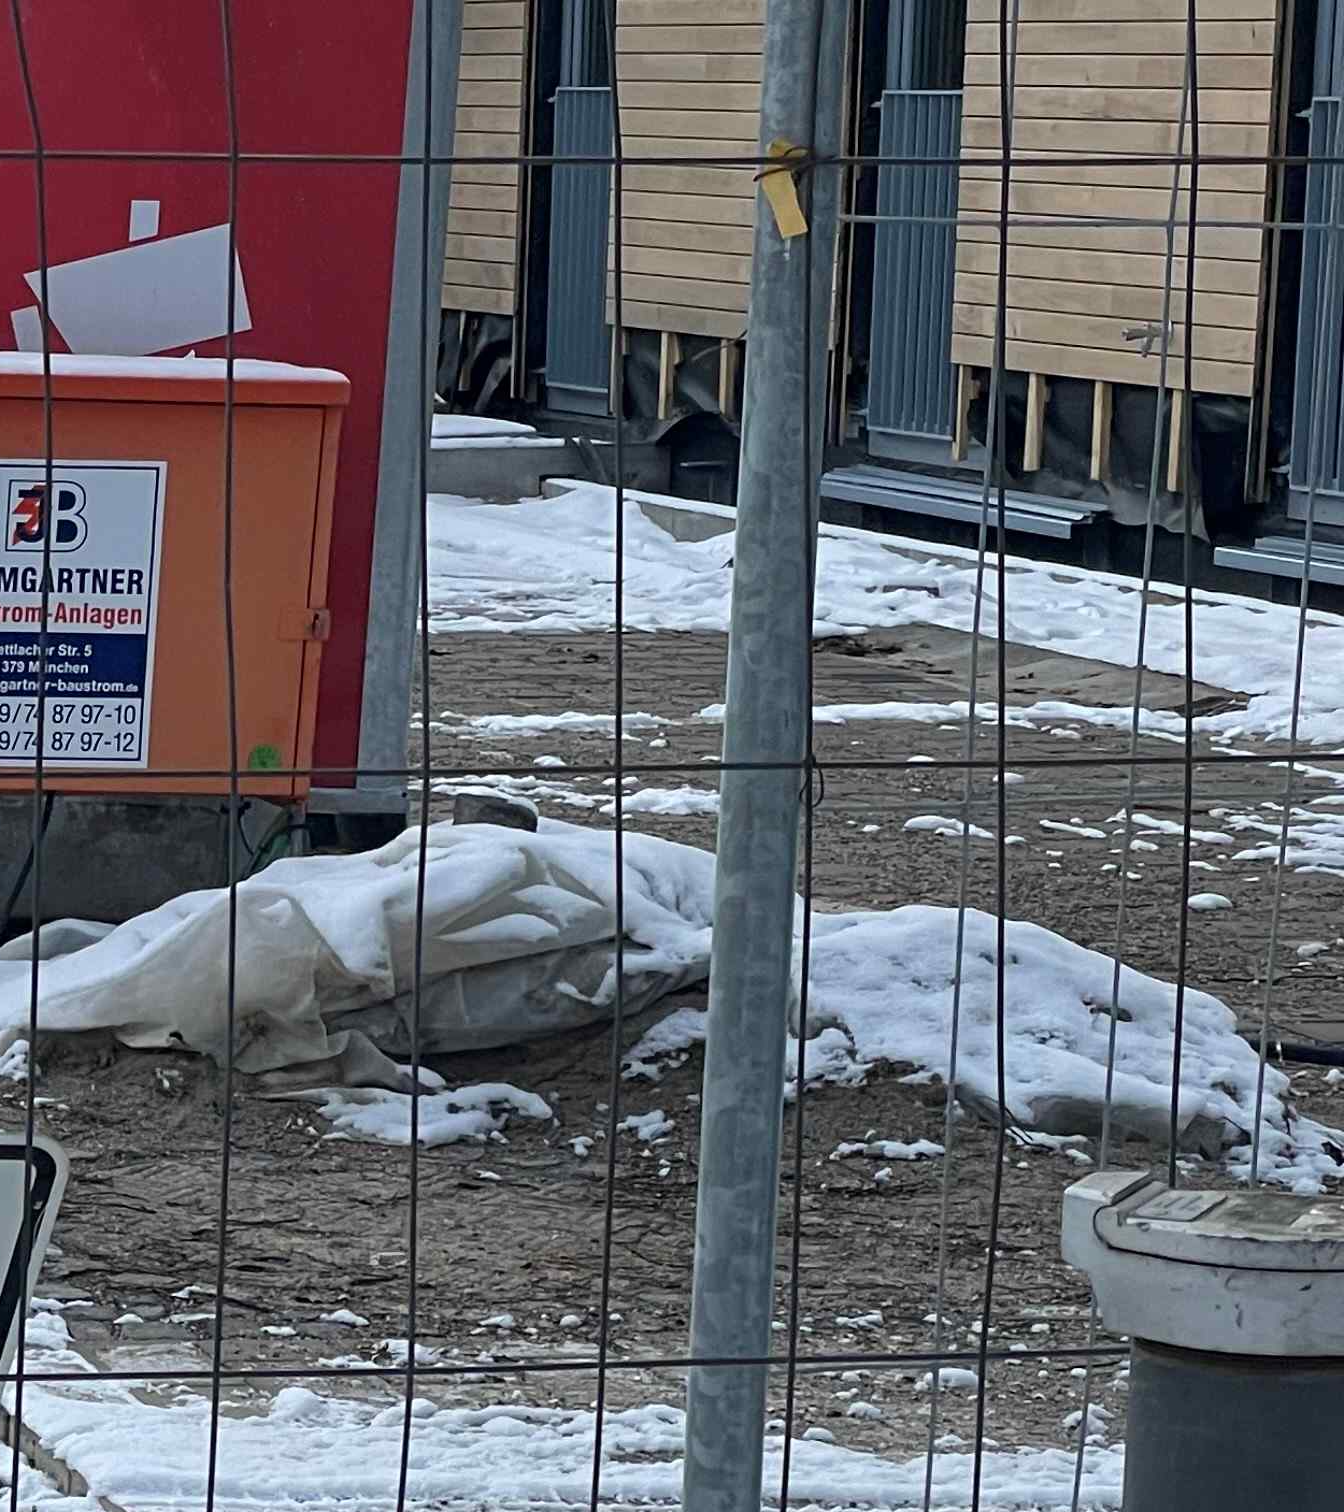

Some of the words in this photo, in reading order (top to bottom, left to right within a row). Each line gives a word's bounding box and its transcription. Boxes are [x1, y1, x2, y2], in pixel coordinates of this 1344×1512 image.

[58, 644, 81, 657] Str.
[84, 645, 92, 657] 5
[51, 704, 76, 724] 87
[80, 705, 136, 724] 97-10
[51, 731, 75, 752] 87
[79, 732, 135, 752] 97-12
